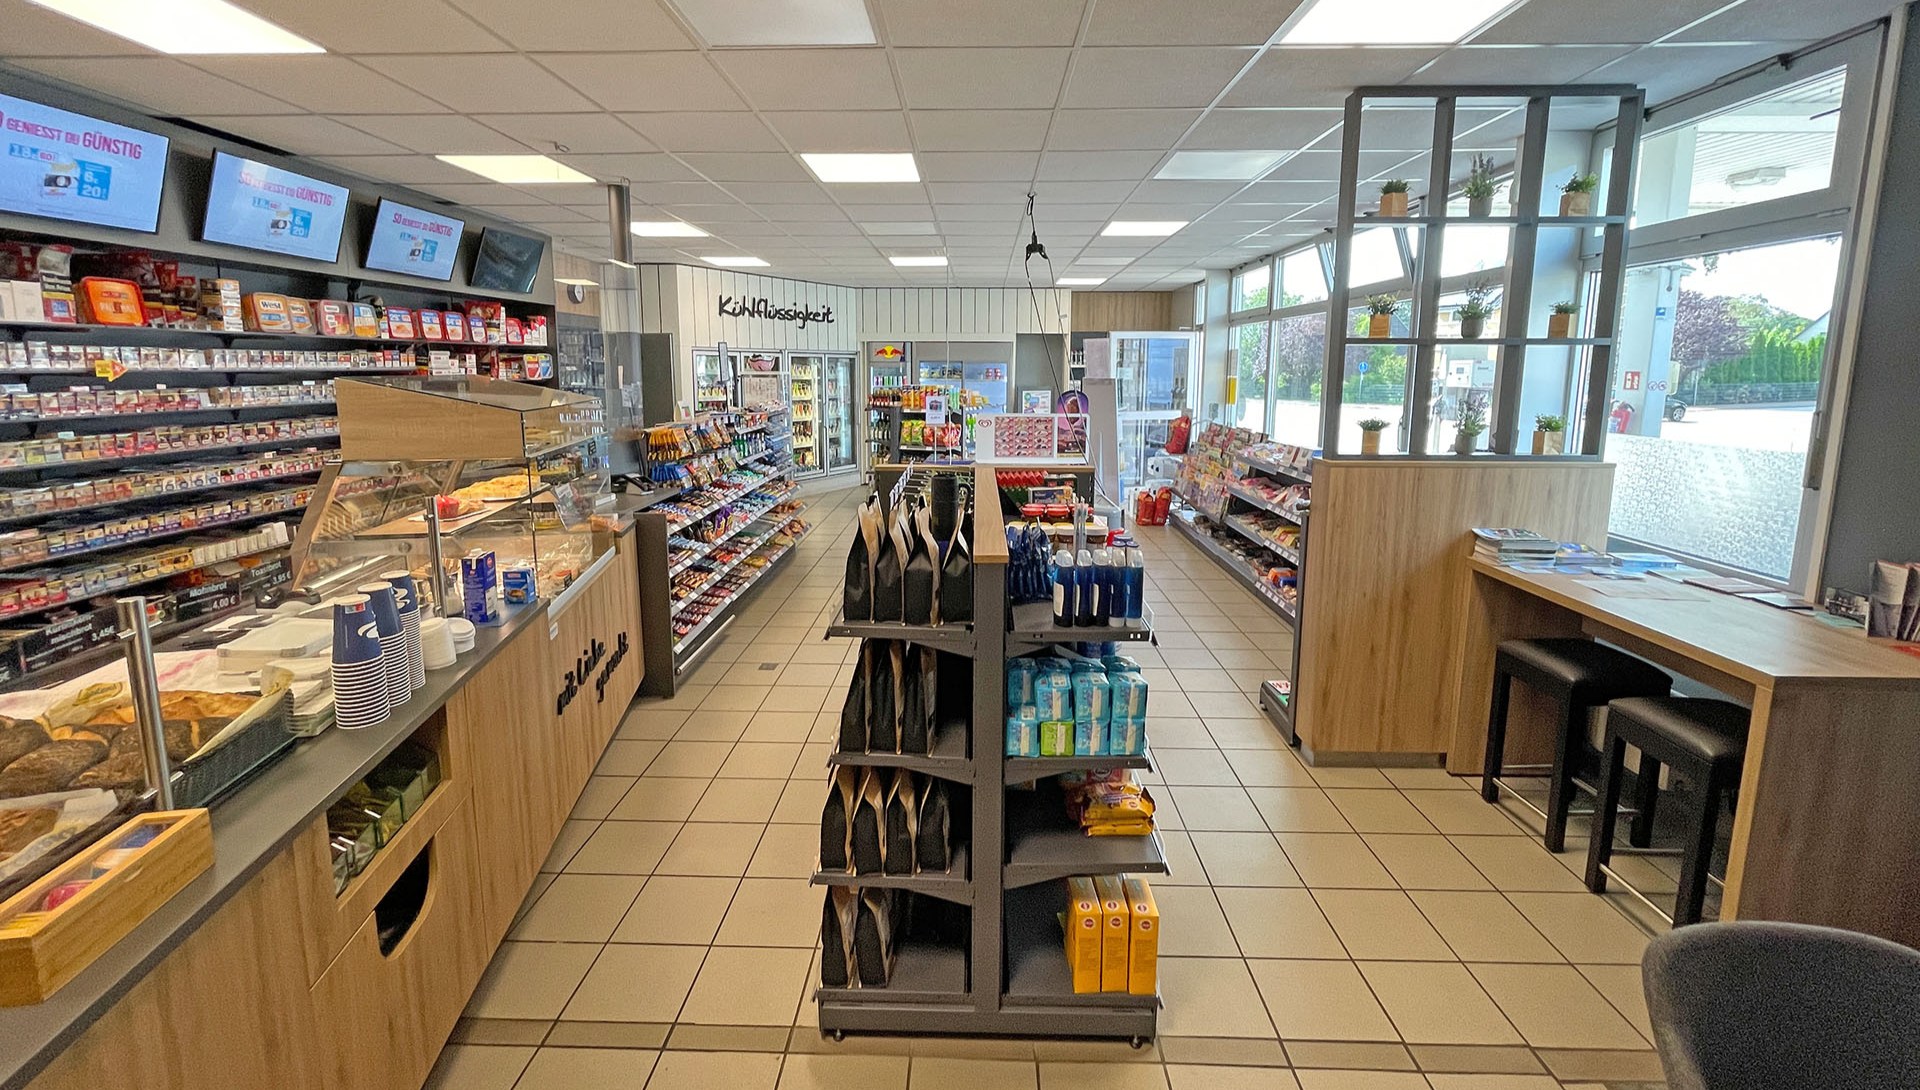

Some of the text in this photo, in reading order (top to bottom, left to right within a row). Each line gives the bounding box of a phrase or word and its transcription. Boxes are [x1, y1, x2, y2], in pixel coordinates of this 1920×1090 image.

[6, 117, 63, 141] GENIESST
[65, 131, 80, 146] DU
[82, 131, 143, 160] GÜNSTIG
[295, 186, 334, 206] GÜNSTIG
[261, 301, 282, 310] West
[718, 294, 835, 330] Kühlflüssigkeit
